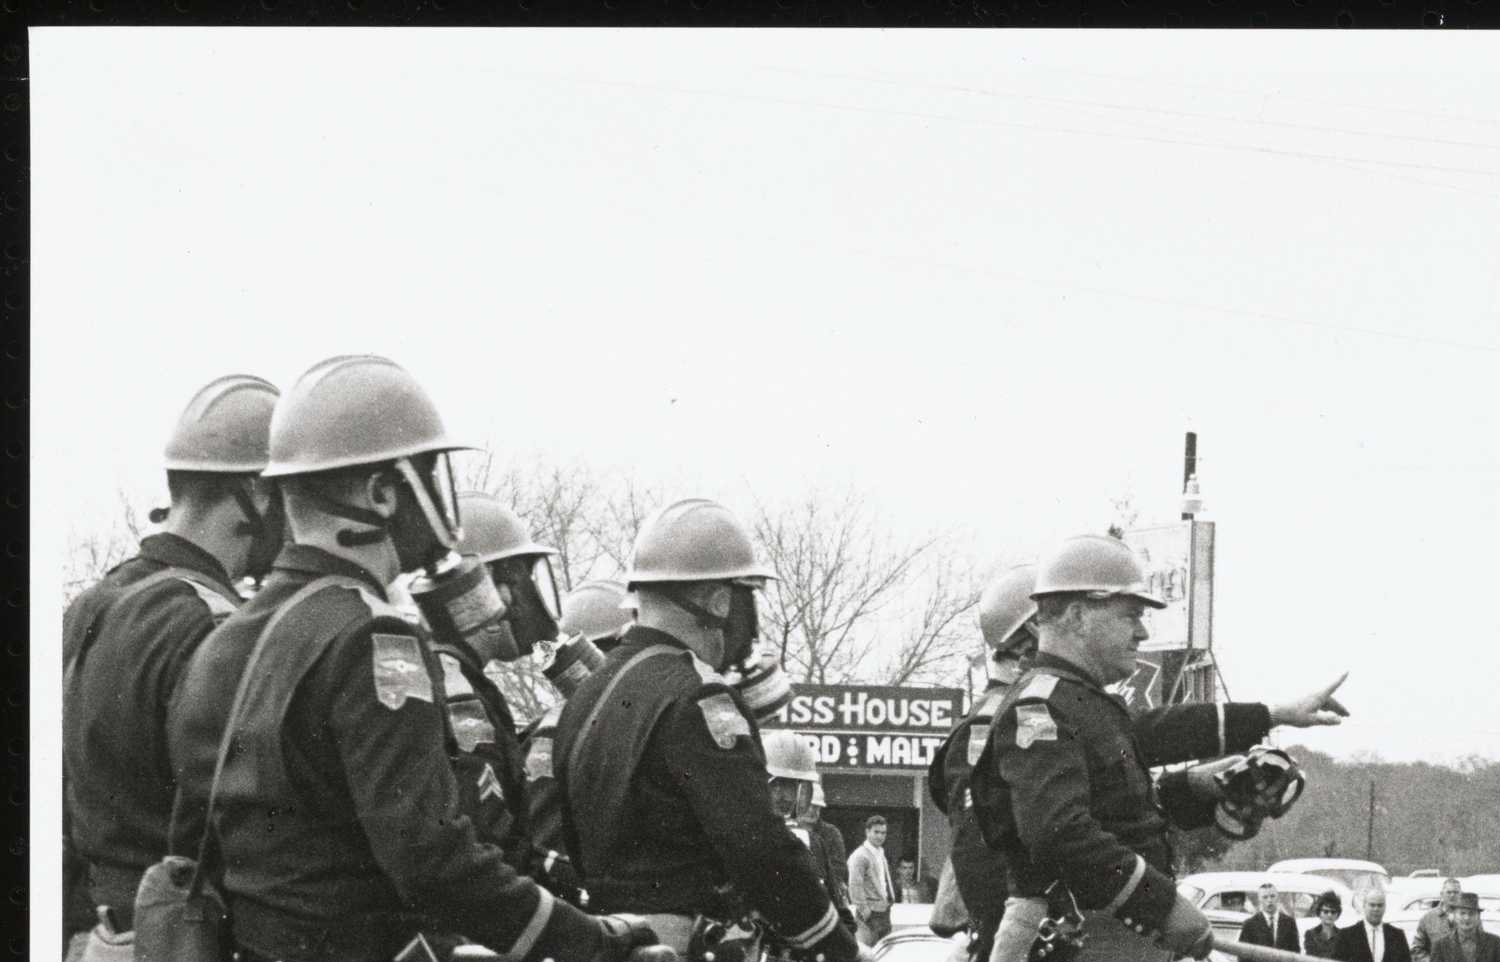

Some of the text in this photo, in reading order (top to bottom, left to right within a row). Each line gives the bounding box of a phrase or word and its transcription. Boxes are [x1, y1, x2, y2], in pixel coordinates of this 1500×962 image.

[838, 692, 952, 727] HOUSE
[806, 735, 946, 765] RD MALT
